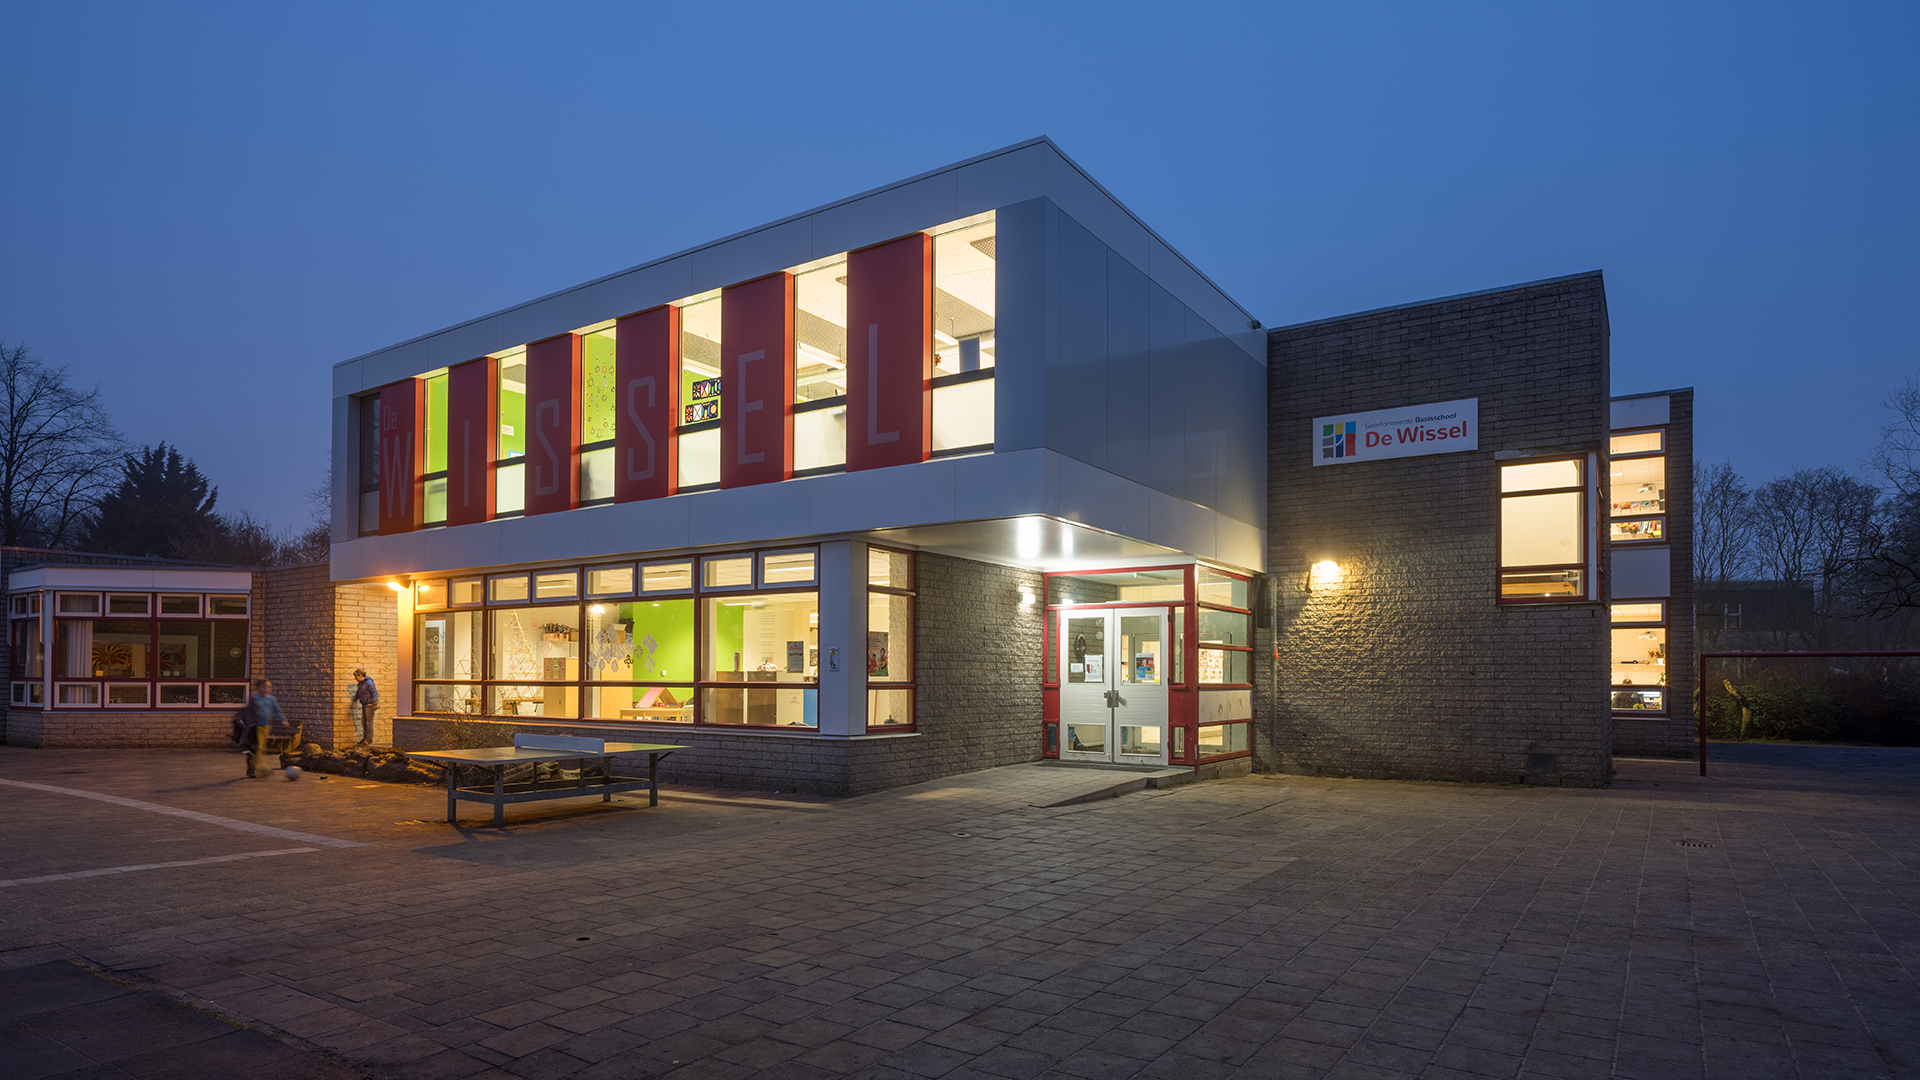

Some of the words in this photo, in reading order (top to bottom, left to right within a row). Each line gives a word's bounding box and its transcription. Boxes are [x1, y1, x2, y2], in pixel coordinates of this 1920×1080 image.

[383, 404, 398, 432] De
[1365, 418, 1414, 429] Gereformeerde
[1415, 412, 1457, 423] Basisschool
[1365, 431, 1393, 448] De
[1396, 420, 1467, 444] Wissel
